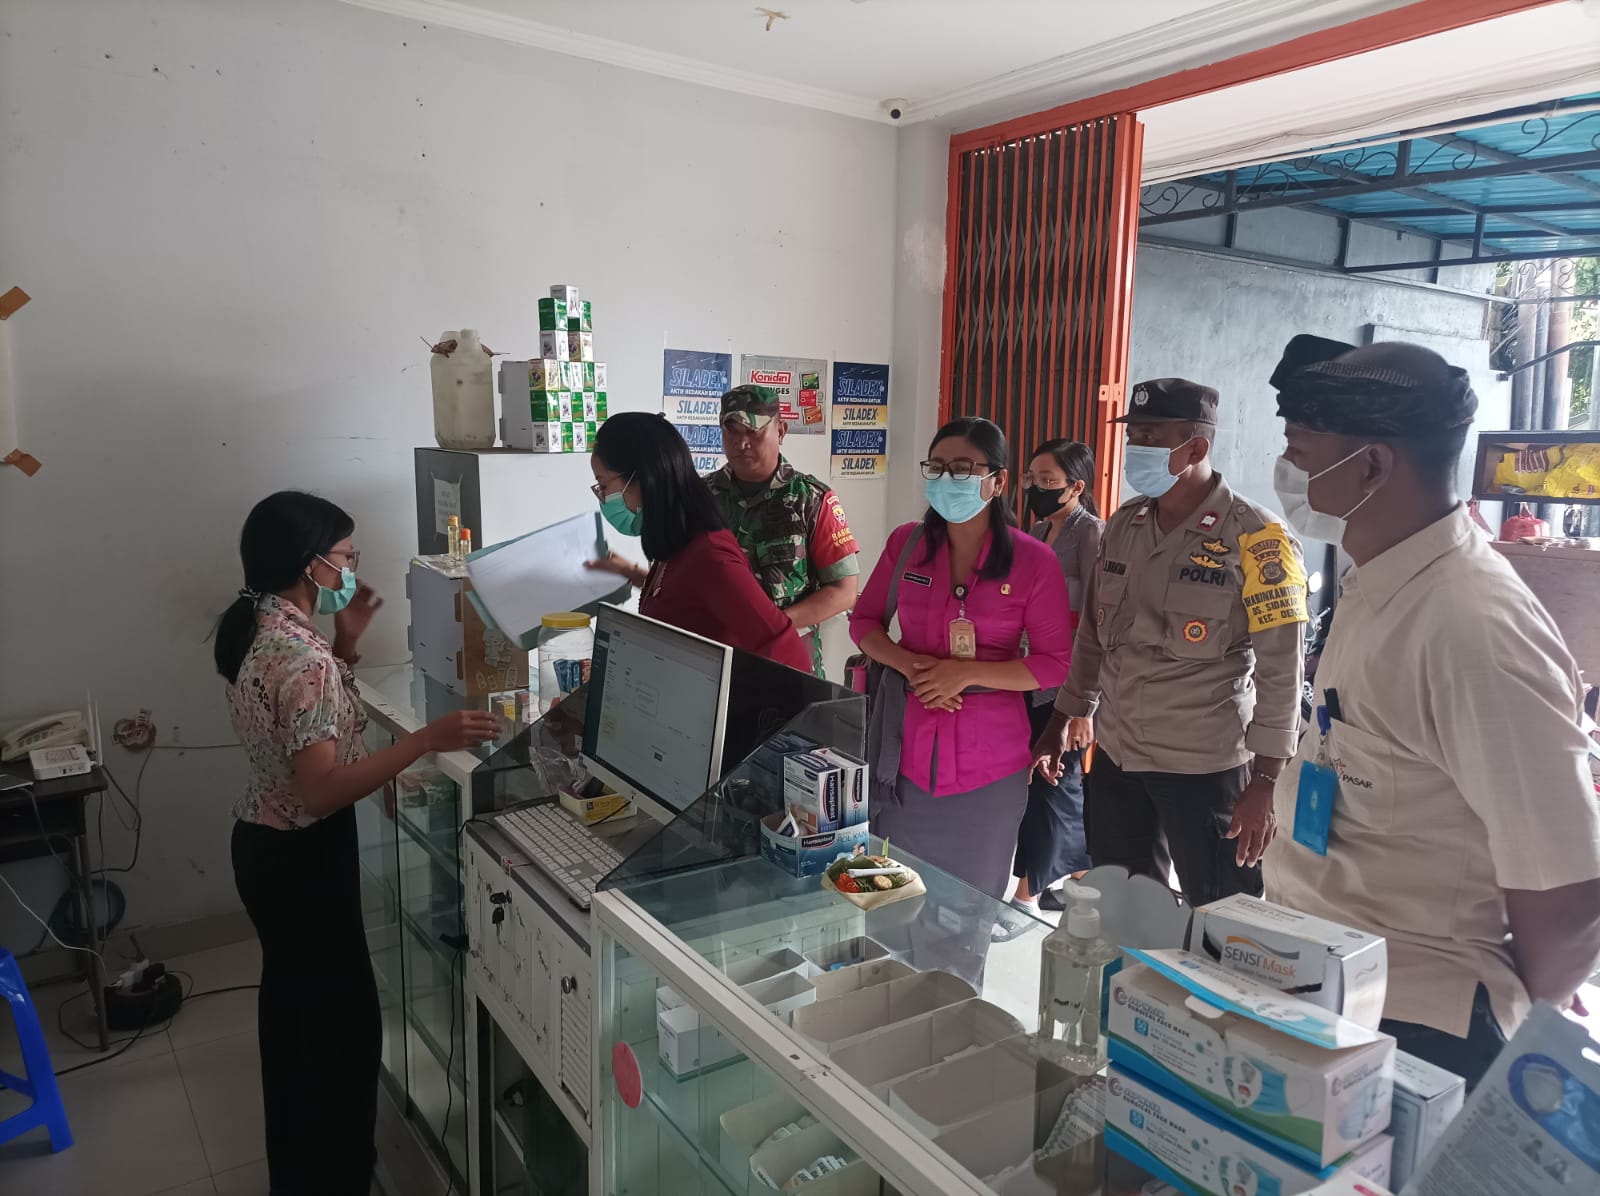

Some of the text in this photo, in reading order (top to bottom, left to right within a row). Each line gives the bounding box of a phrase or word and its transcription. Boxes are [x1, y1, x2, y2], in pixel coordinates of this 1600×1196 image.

[670, 368, 725, 389] SILADEX
[751, 370, 791, 384] Konidin
[837, 379, 883, 397] SILADEX
[677, 400, 719, 415] SILADEX
[843, 408, 878, 420] SILADEX
[836, 430, 881, 447] SILADEX
[841, 457, 876, 469] SILADEX
[1180, 568, 1226, 586] POLRI
[1257, 613, 1277, 625] KEC.
[1343, 774, 1373, 789] PASAR
[828, 774, 838, 820] Hansaplast
[802, 833, 835, 846] Hansaplast
[1224, 946, 1261, 968] SENSI
[1262, 957, 1297, 978] Mask
[1173, 1024, 1190, 1038] MASK
[1168, 1121, 1186, 1134] MASK
